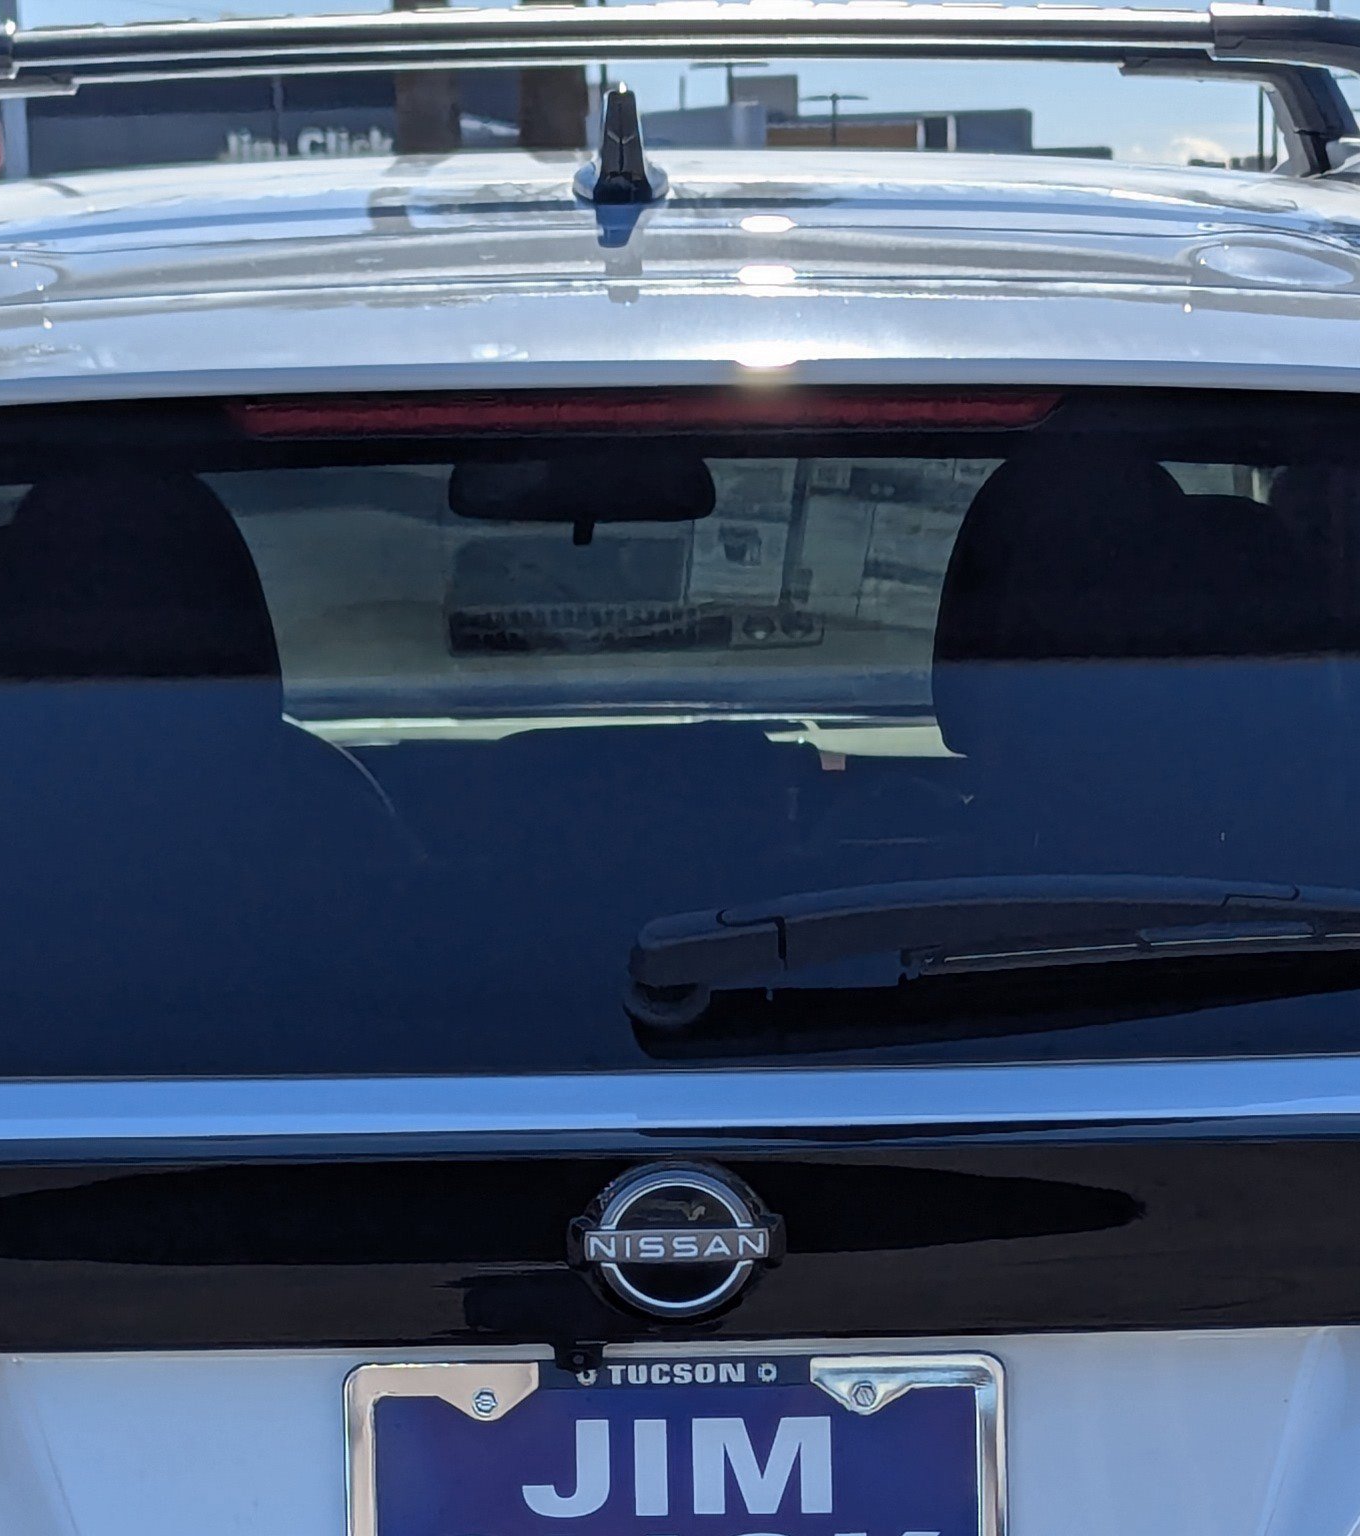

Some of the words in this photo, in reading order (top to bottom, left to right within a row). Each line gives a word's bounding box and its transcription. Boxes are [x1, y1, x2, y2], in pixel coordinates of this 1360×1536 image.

[587, 1230, 766, 1259] NISSAN
[607, 1362, 746, 1385] TUCSON
[521, 1416, 833, 1518] JIM
